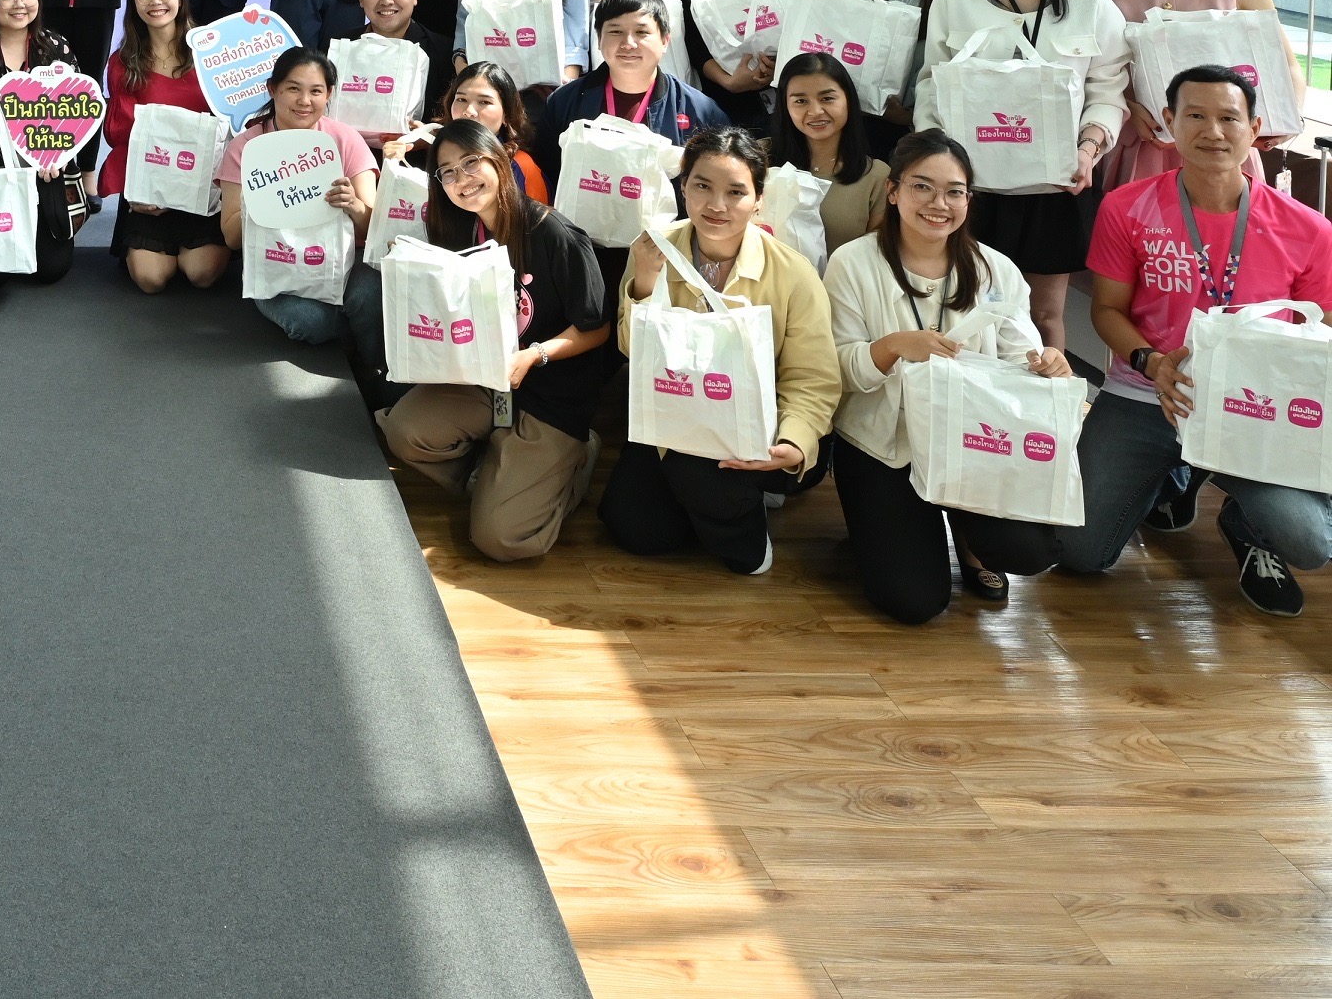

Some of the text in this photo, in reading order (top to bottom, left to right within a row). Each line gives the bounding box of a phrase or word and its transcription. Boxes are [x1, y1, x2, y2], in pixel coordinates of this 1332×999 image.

[203, 31, 284, 69] ขอส่งกำลังใจ
[39, 69, 54, 77] mtl
[3, 94, 101, 118] ป็นกำลังใจ
[25, 126, 73, 149] ให้นะ
[247, 146, 335, 191] เป็นกำลังใจ
[276, 185, 322, 208] ให้นะ
[1143, 256, 1193, 277] FOR
[1144, 271, 1193, 294] FUN
